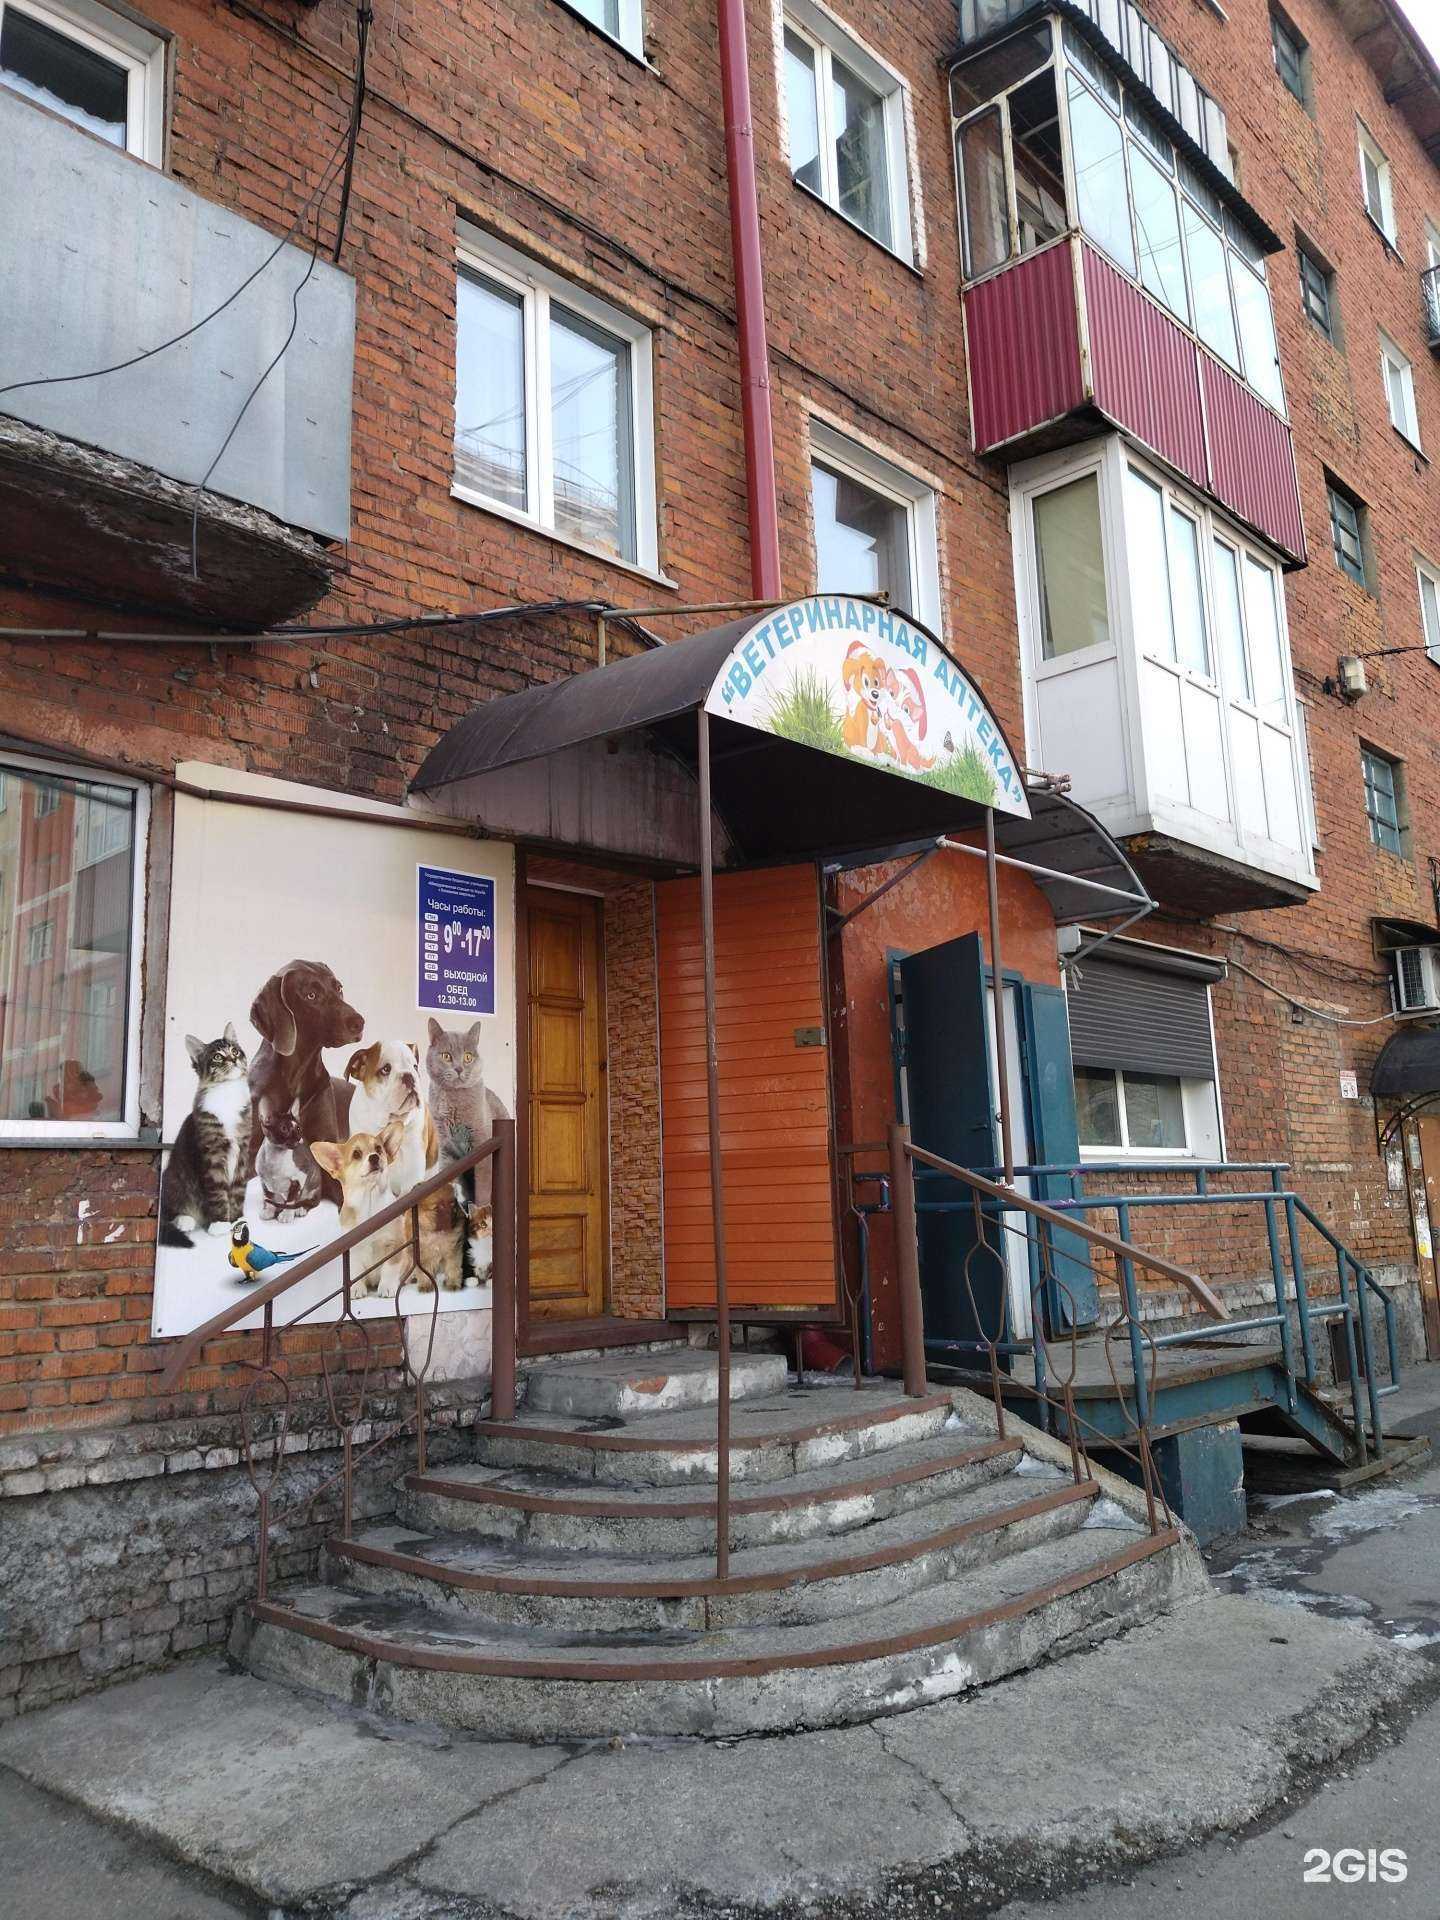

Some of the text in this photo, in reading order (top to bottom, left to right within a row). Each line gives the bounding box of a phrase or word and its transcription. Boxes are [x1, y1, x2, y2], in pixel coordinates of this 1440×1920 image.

[427, 898, 486, 918] Часы работы:
[443, 969, 488, 983] ВЫХОДНОЙ
[446, 984, 468, 996] ОБЕД
[437, 994, 477, 1007] 12.30-13.00
